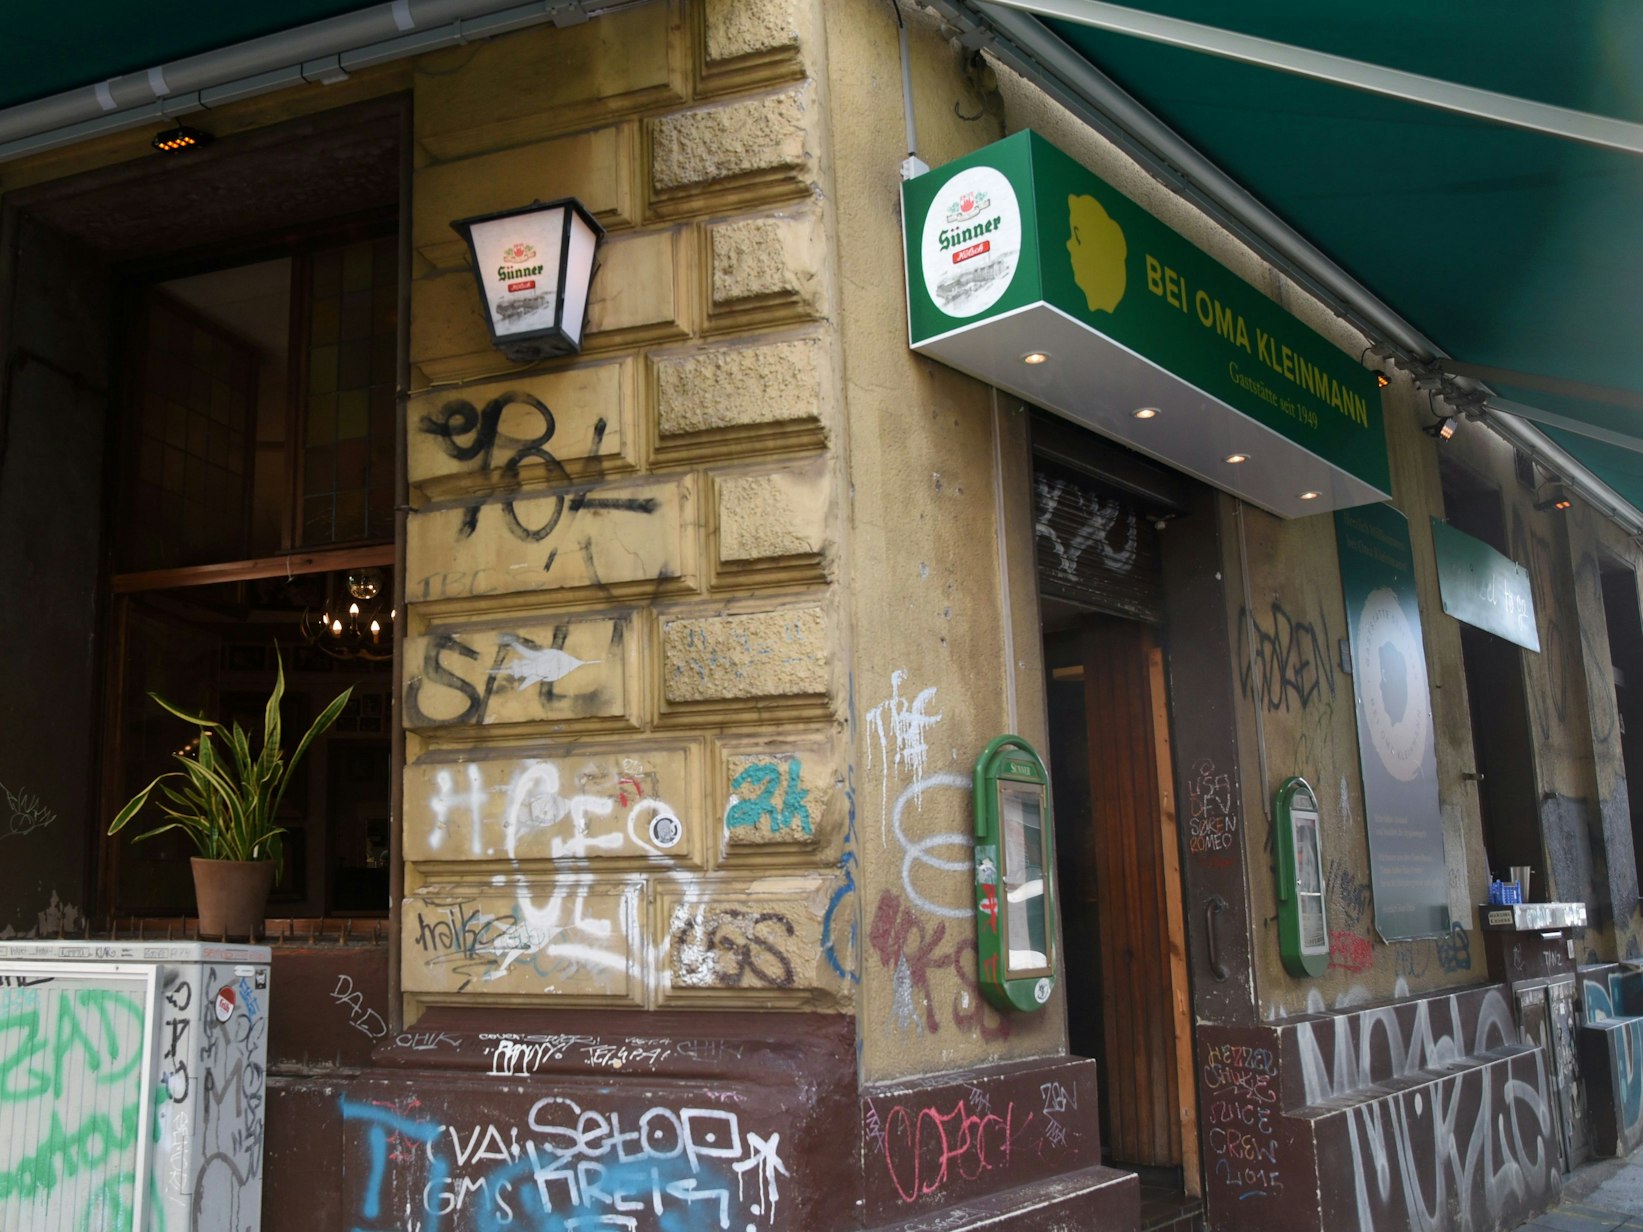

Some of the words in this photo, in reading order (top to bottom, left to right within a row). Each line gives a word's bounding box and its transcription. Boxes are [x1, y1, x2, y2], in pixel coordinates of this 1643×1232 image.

[939, 216, 1001, 252] Sünner
[497, 264, 544, 281] Sünner
[1146, 254, 1188, 314] BEI
[1196, 290, 1251, 353] OMA
[1256, 328, 1368, 428] KLEINMANN
[1229, 361, 1278, 406] Gaststätte
[1280, 396, 1296, 417] seit
[1297, 404, 1318, 429] 1949
[1210, 1128, 1278, 1165] CREW
